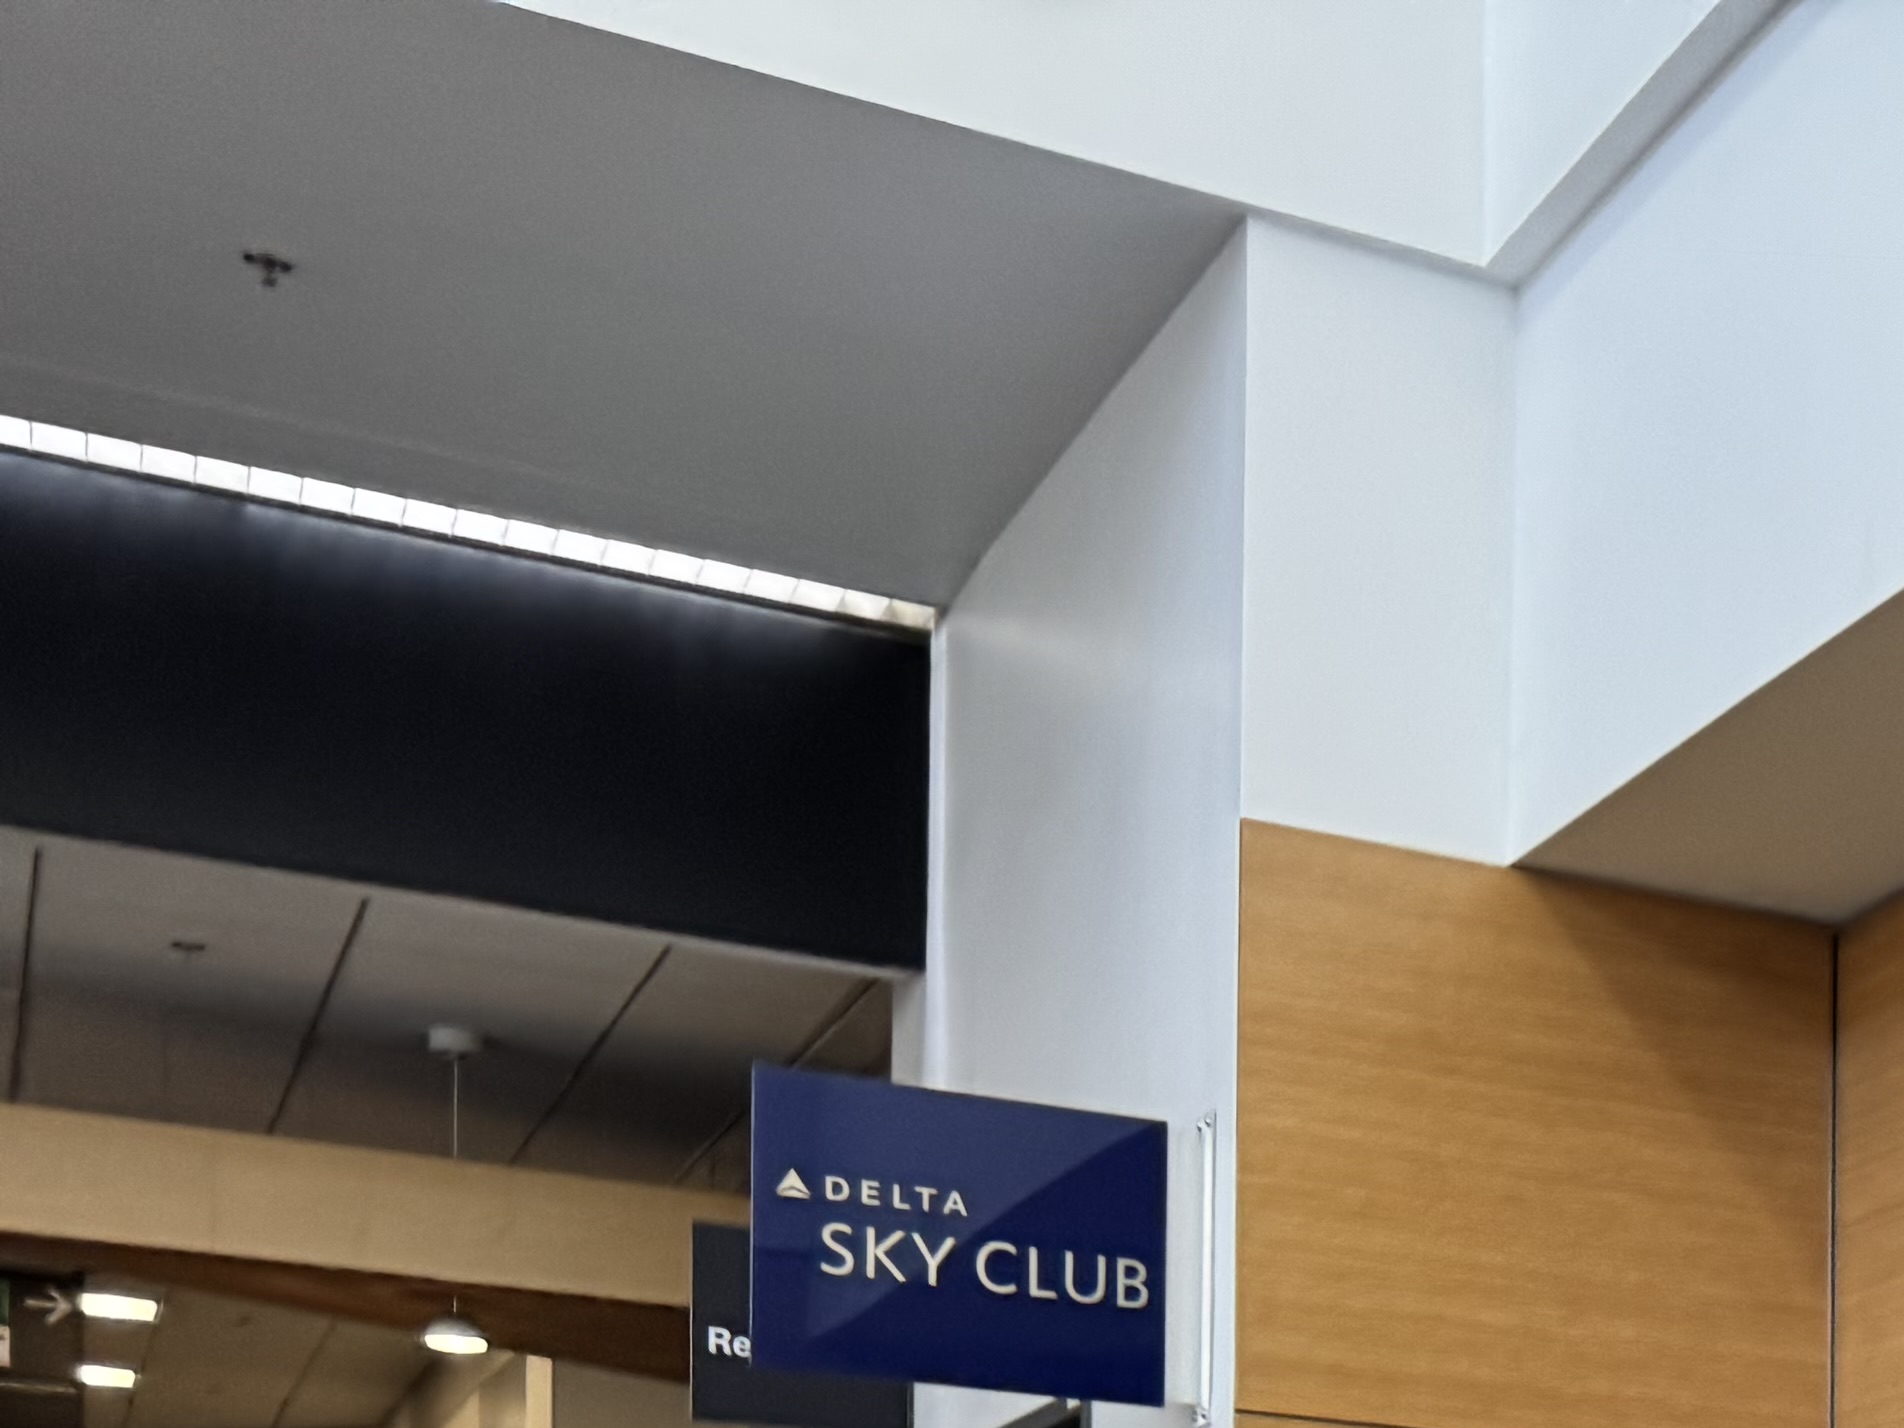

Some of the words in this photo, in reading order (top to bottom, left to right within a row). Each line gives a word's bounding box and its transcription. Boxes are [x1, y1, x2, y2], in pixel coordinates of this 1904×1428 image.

[823, 1175, 968, 1217] DELTA
[819, 1222, 956, 1287] SKY
[975, 1241, 1149, 1309] CLUB
